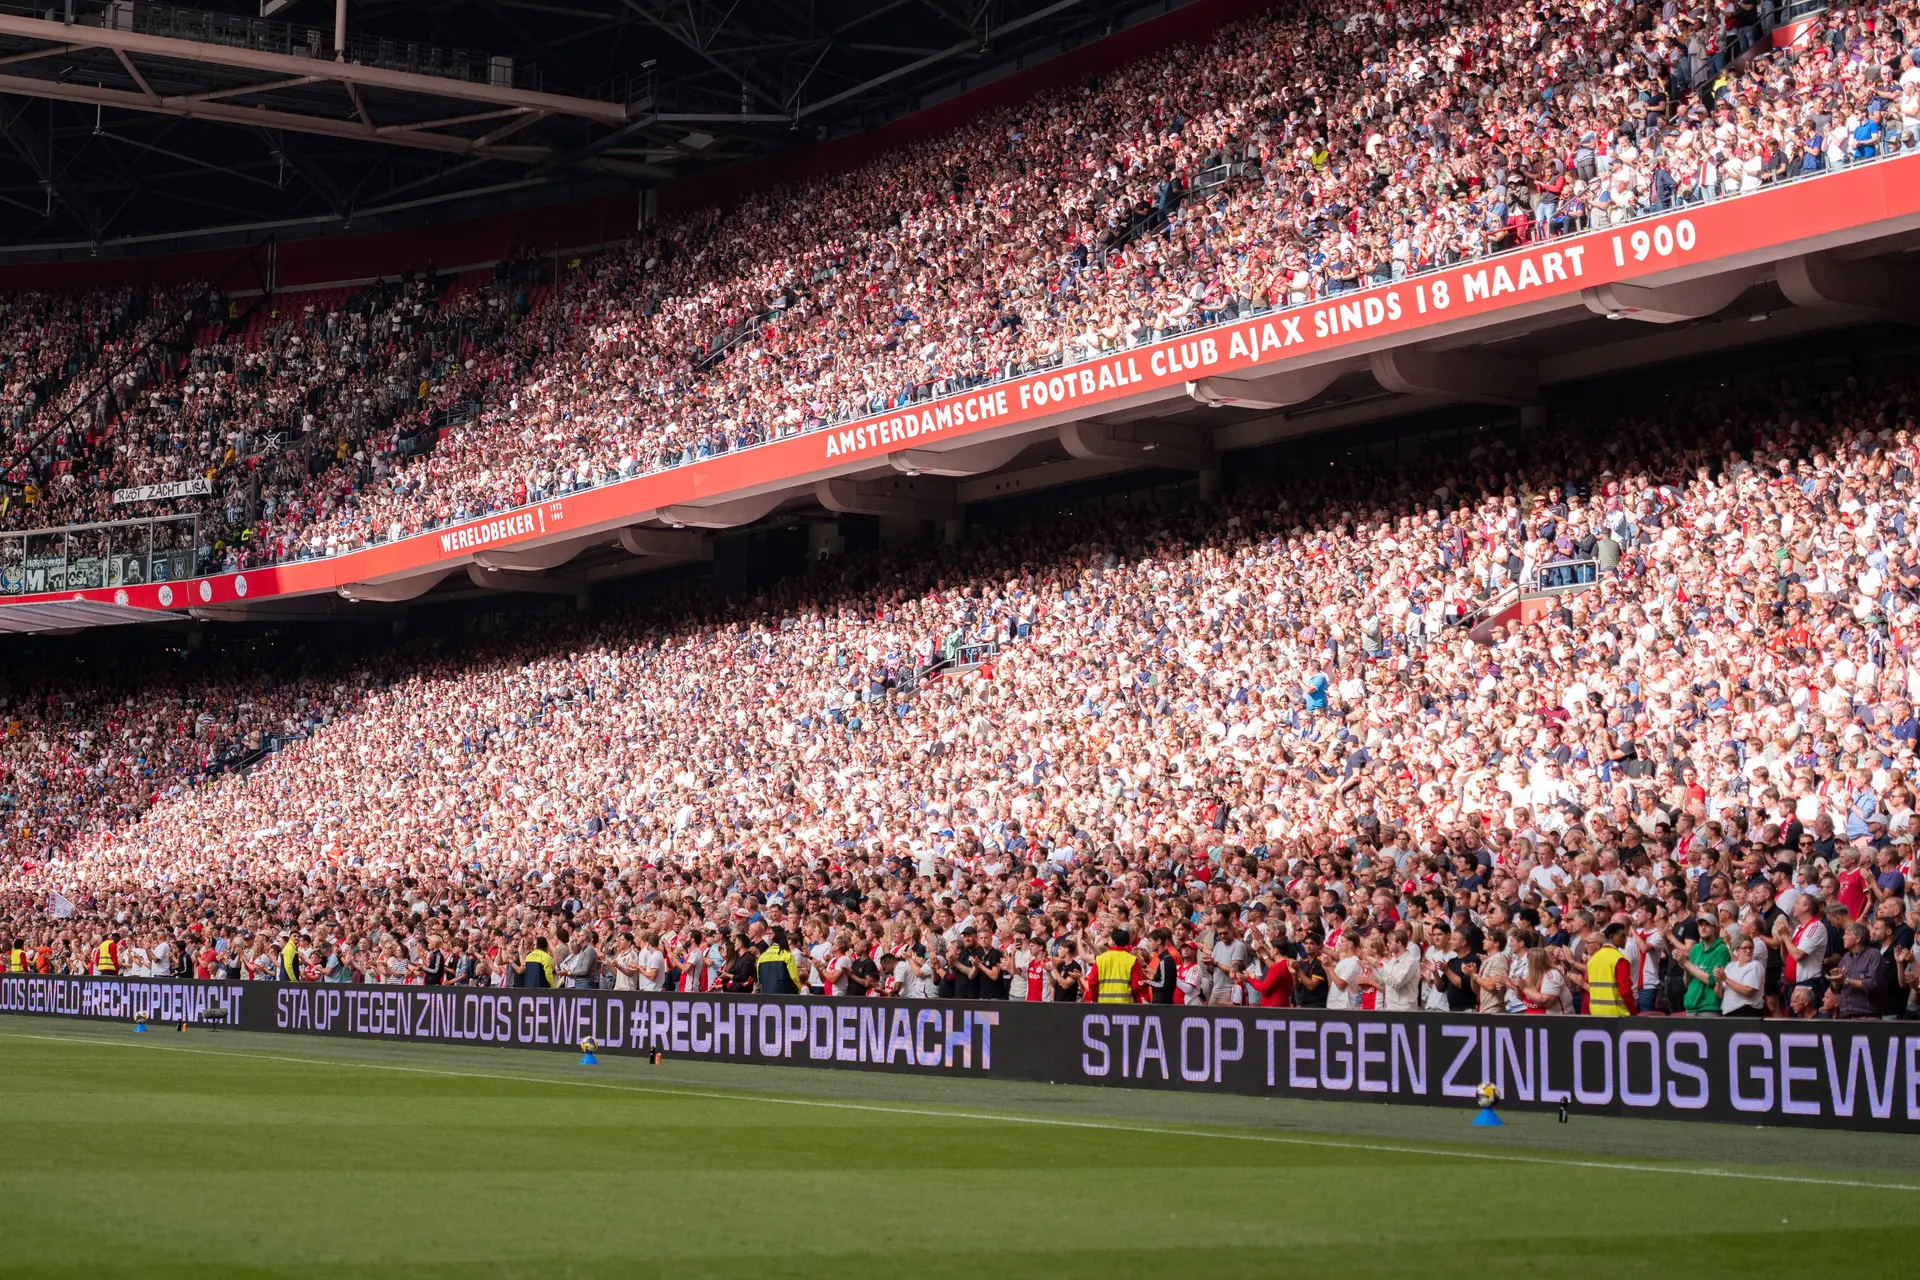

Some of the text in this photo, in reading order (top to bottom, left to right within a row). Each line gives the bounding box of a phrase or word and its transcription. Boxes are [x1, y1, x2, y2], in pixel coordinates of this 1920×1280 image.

[826, 219, 1697, 457] AMSTERDAMSCHE FOOTBALL CLUB AJAX SINDS 18 MAART 1900
[147, 482, 182, 499] ZACHT
[441, 513, 534, 552] WERELDBEKER
[28, 979, 80, 1015] GEWELD
[83, 981, 244, 1025] #RECHTOPDENACHT
[277, 988, 1000, 1070] STA OP TEGEN ZINLOOS GEWELD #RECHTOPDENACHT
[1082, 1014, 1169, 1080] STA
[1180, 1017, 1244, 1083] OP
[1255, 1019, 1427, 1095] TEGEN
[1441, 1025, 1709, 1108] ZINLOOS
